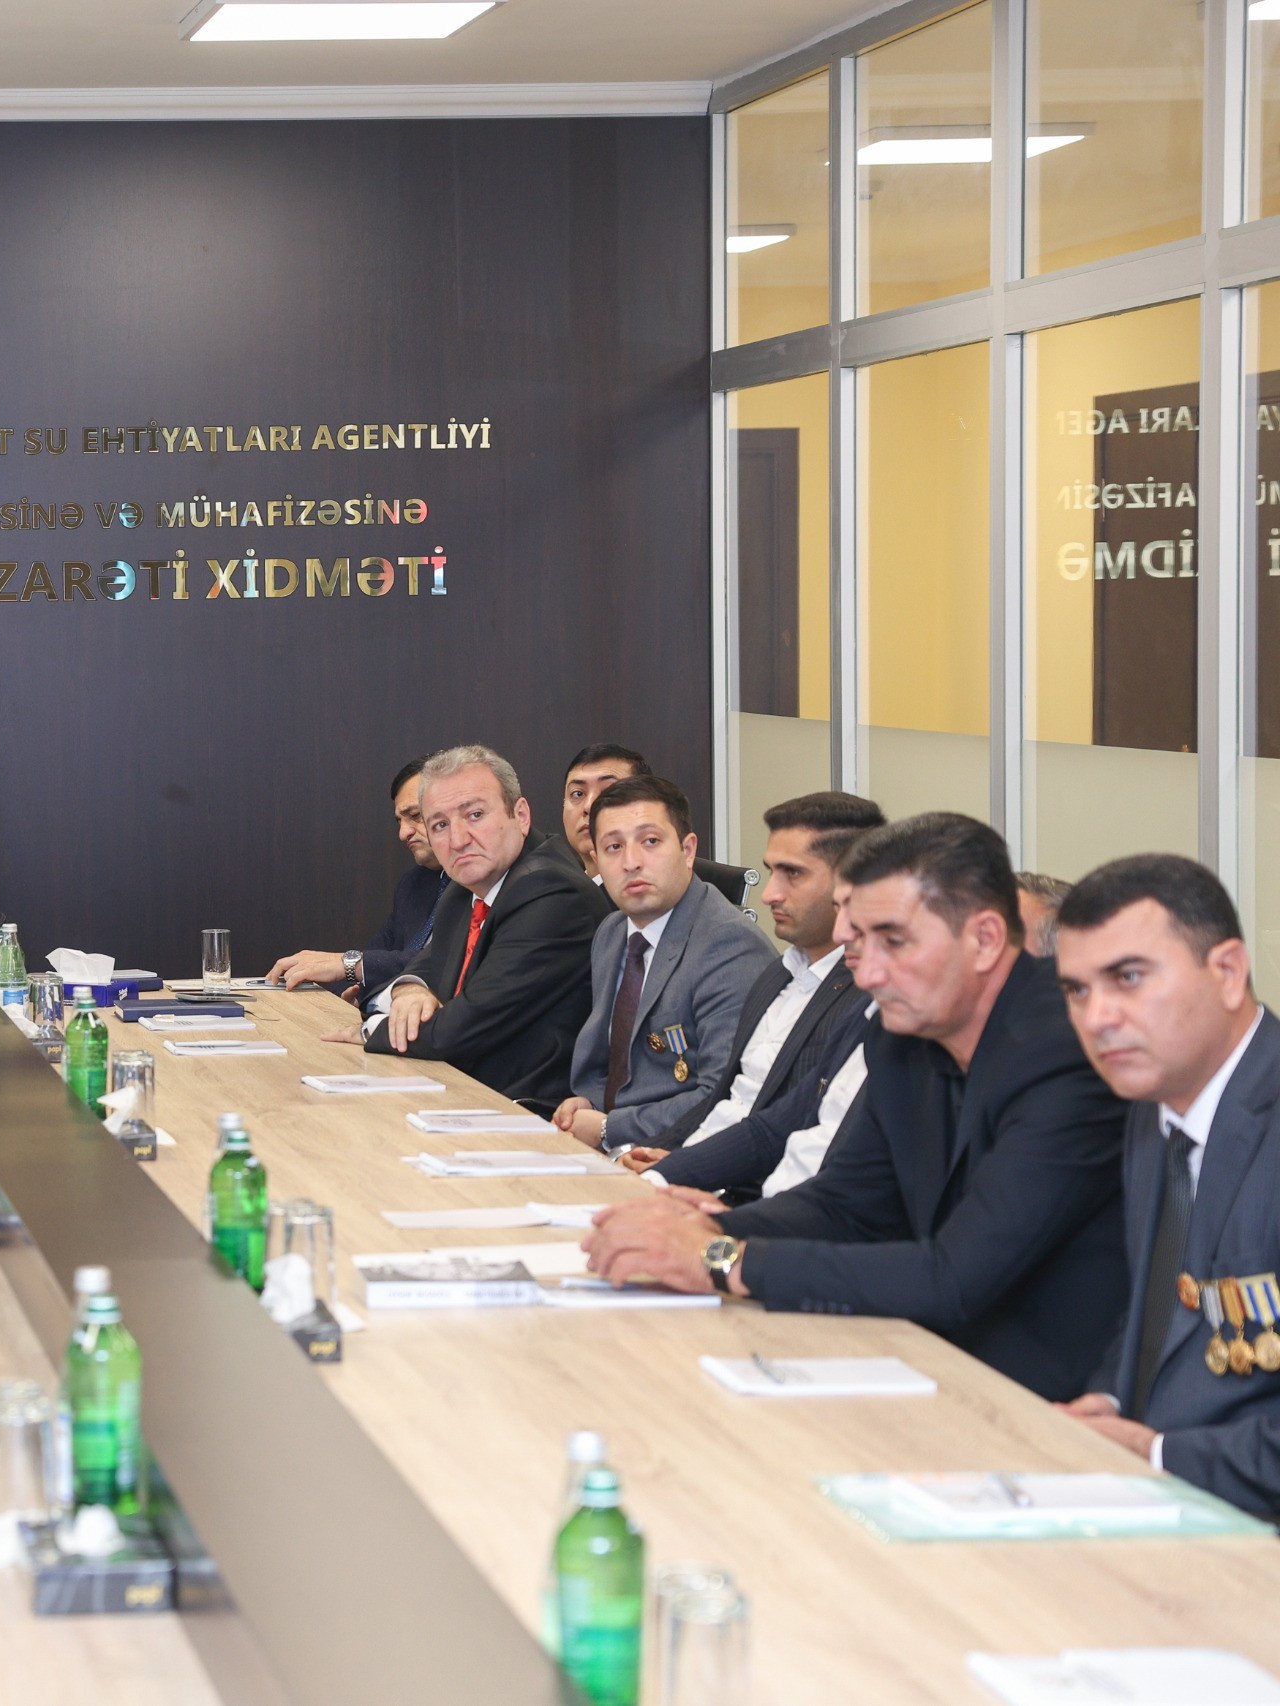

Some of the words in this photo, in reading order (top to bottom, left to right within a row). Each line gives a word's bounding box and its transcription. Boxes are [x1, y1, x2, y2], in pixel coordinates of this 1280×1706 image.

[23, 428, 68, 456] SU
[82, 419, 302, 454] EHTİYATLARI
[312, 417, 491, 451] AGENTLİYİ
[94, 502, 145, 530] VƏ
[156, 493, 428, 529] MÜHAFİZƏSİNƏ
[205, 546, 447, 600] XİDMƏTİ
